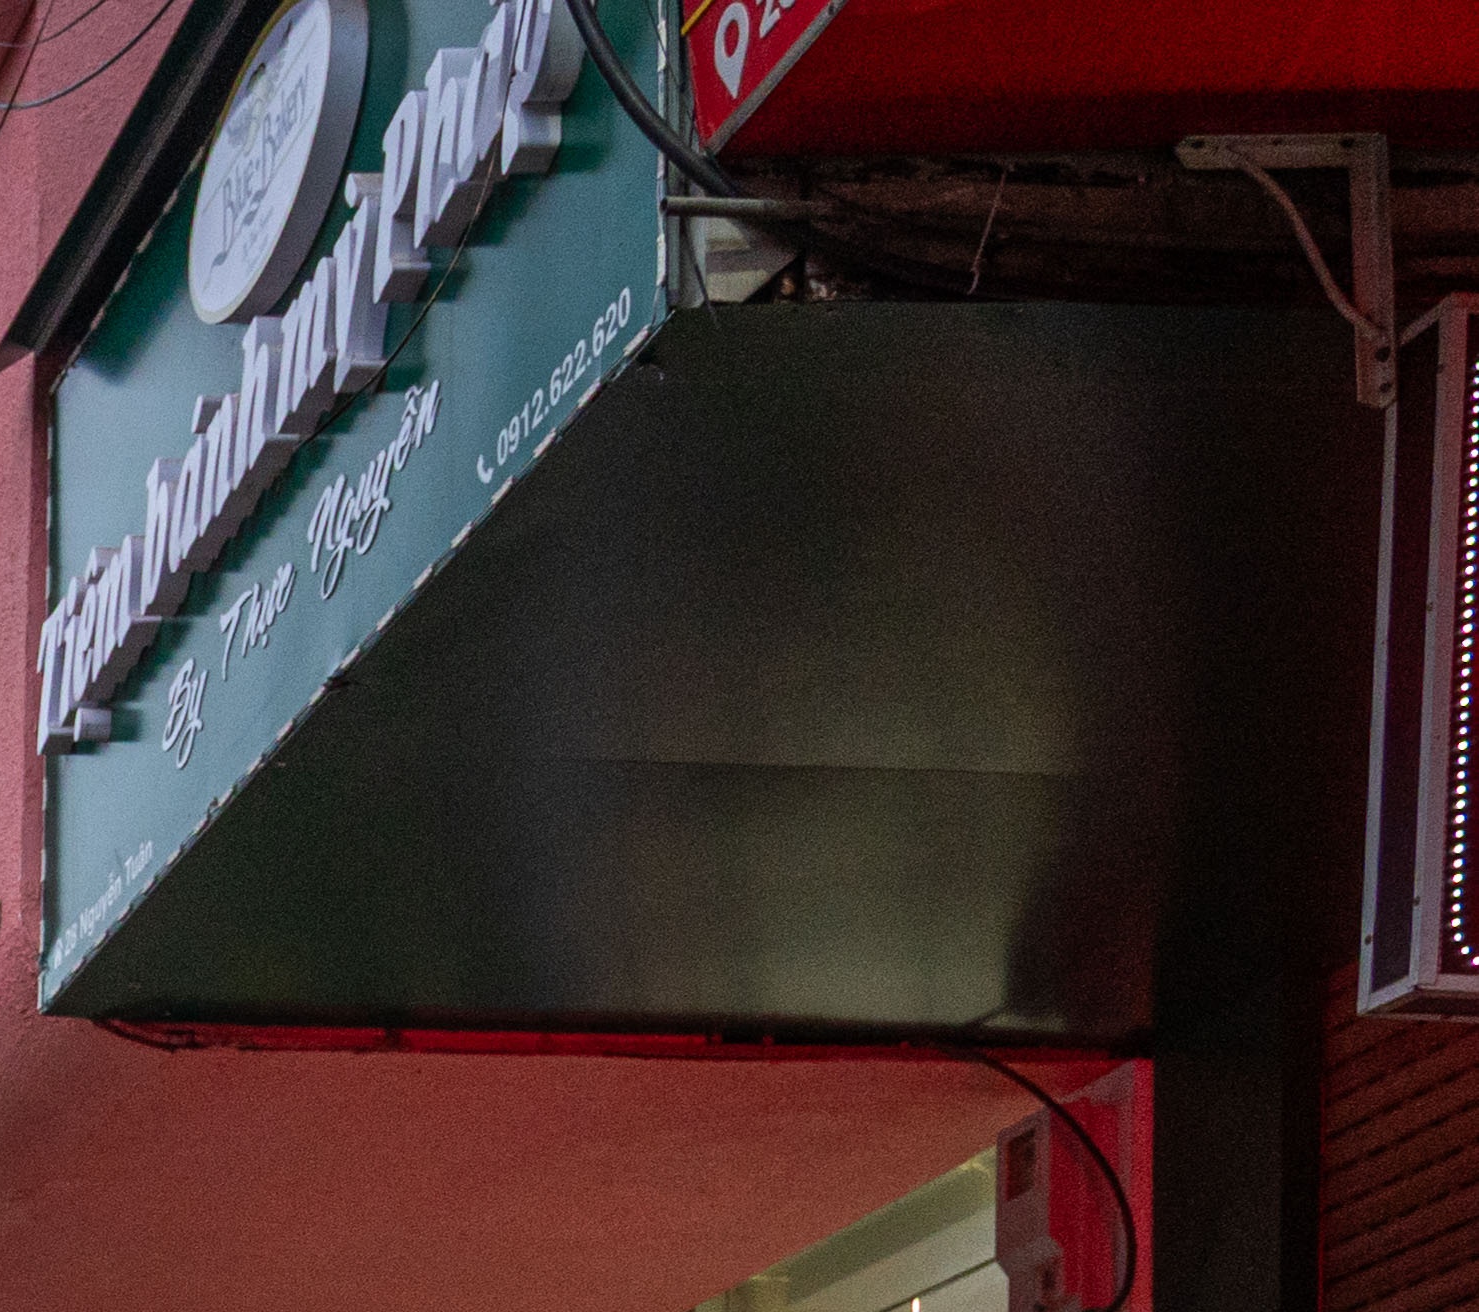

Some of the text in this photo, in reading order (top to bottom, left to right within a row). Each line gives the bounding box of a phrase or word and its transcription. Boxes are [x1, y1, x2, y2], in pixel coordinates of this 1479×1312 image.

[141, 318, 267, 616] bánh
[496, 286, 633, 468] 0912.622.620
[163, 657, 209, 768] By
[307, 377, 443, 600] Nguyễn
